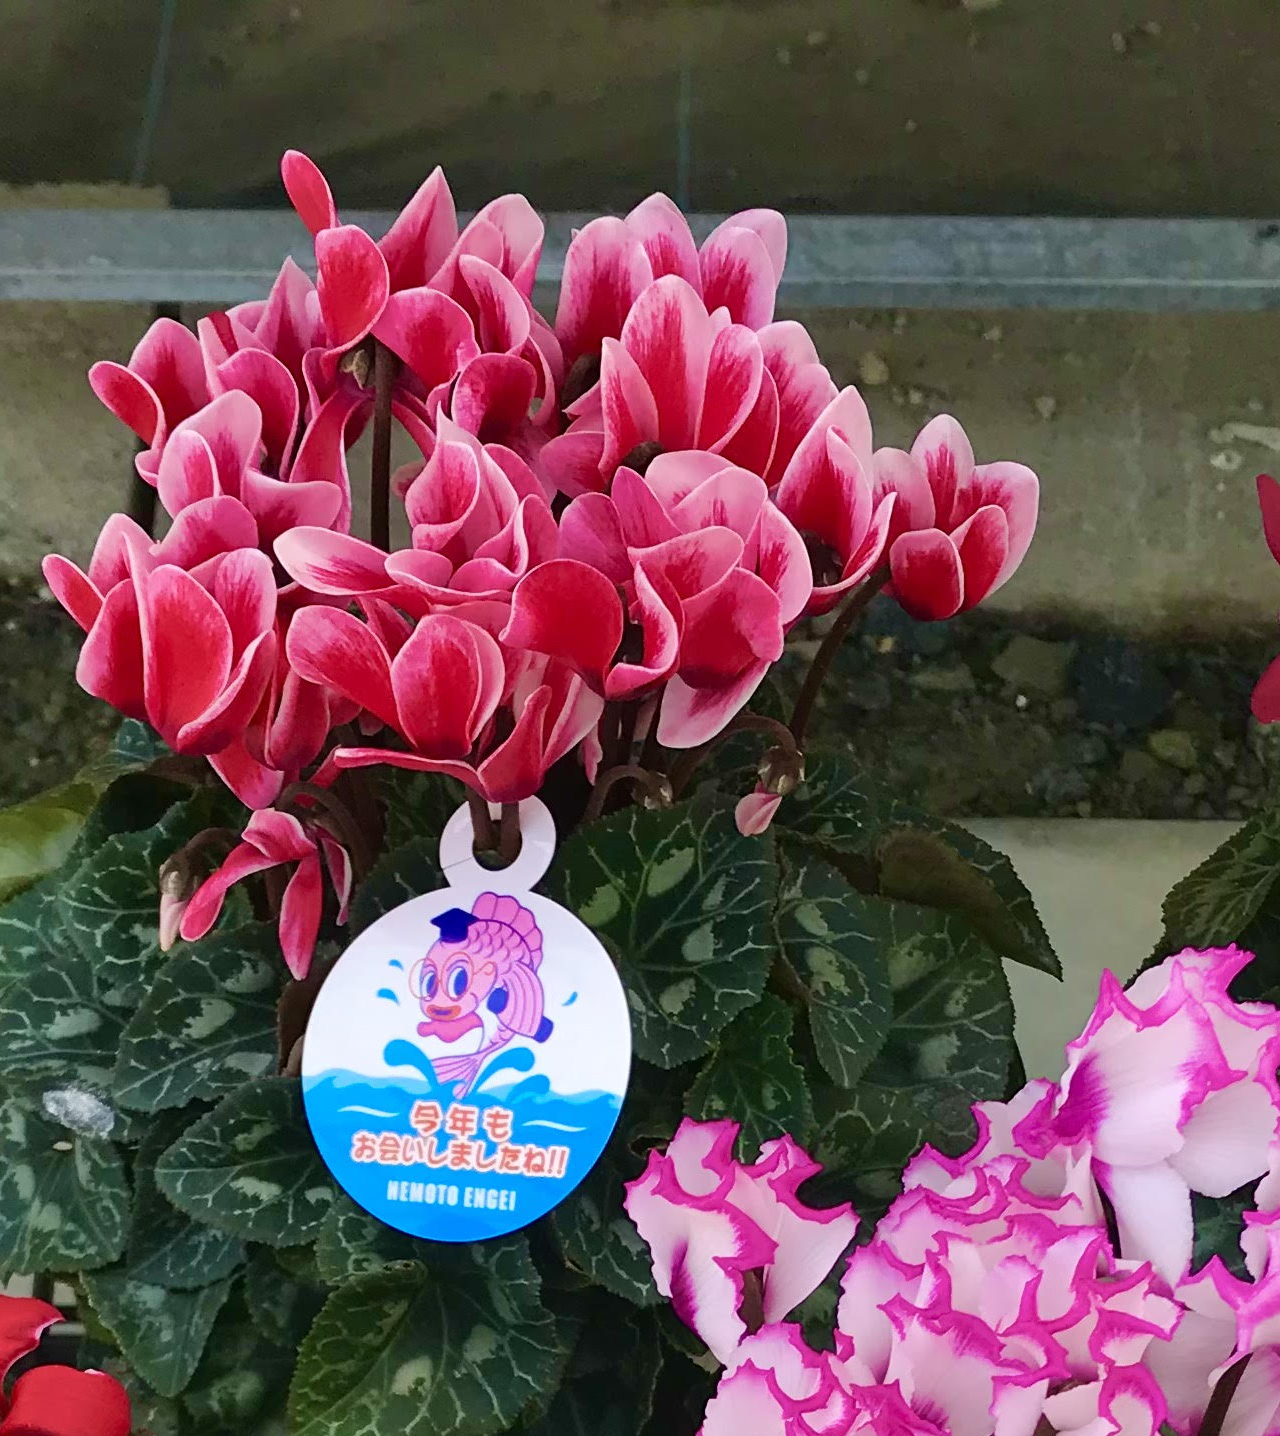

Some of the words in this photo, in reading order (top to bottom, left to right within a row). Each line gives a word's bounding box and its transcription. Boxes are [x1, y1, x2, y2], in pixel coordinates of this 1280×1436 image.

[410, 1101, 513, 1138] 今年も
[387, 1180, 458, 1208] NEMOTO
[463, 1185, 516, 1211] ENGEI
